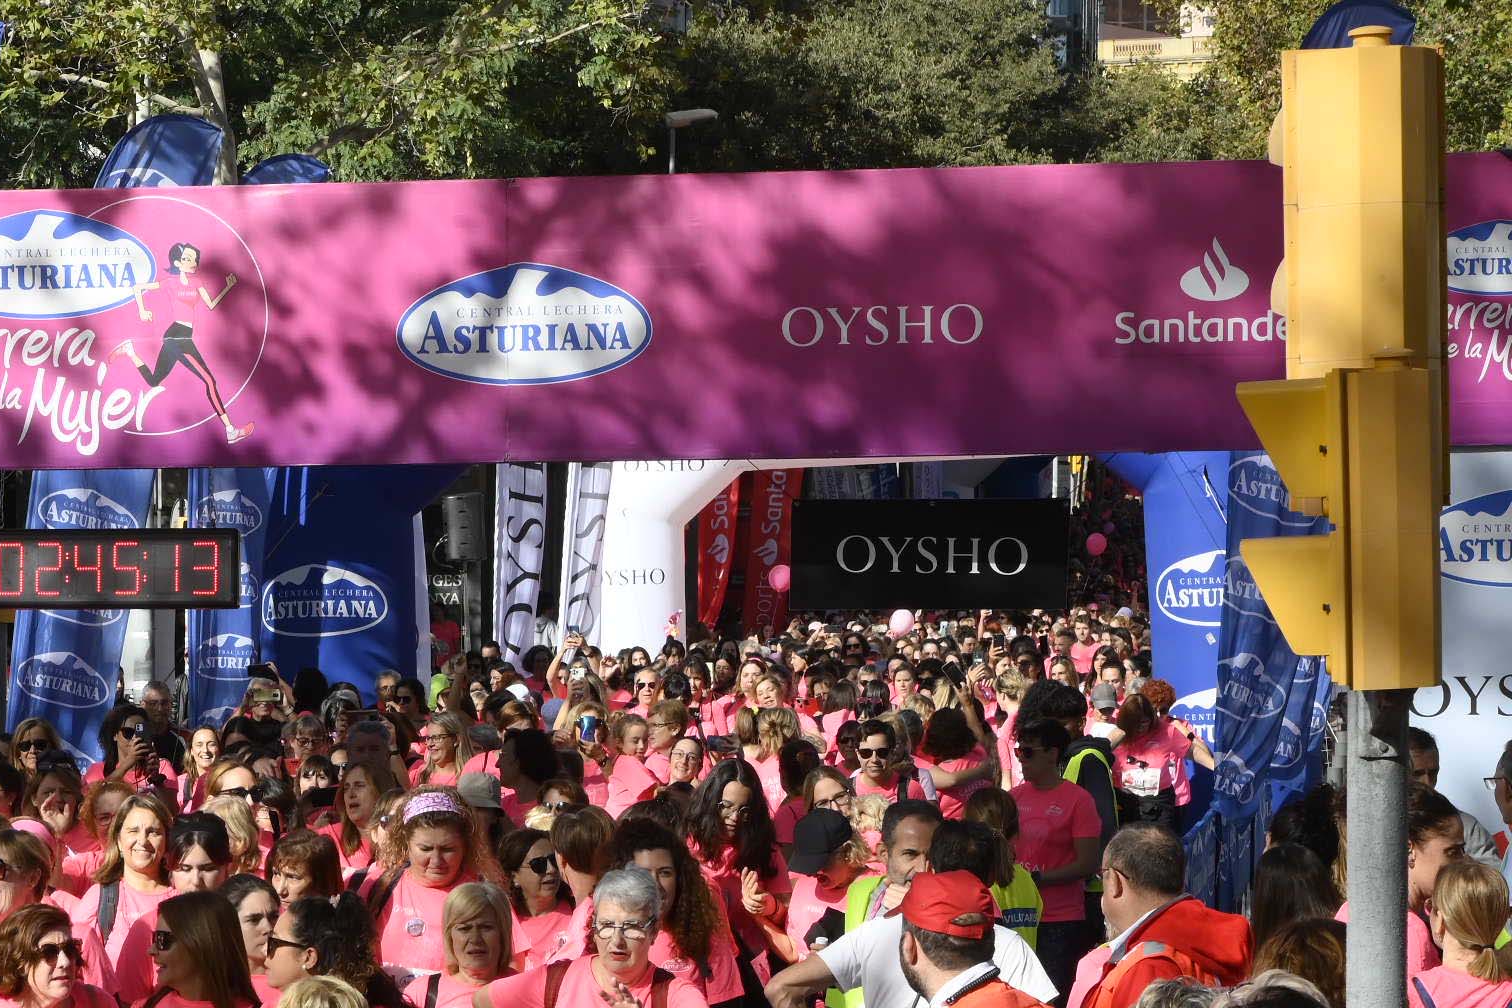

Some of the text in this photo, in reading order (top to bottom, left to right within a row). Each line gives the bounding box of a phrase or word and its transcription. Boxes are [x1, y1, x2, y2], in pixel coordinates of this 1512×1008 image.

[59, 246, 132, 258] LECHERA
[455, 303, 625, 319] CENTRAL LECHERA
[781, 303, 984, 348] OYSHO
[1114, 310, 1288, 344] Santande
[417, 310, 632, 356] ASTURIANA
[17, 362, 166, 456] Mujer
[761, 471, 787, 535] Santa
[836, 535, 1029, 576] OYSHO
[325, 588, 376, 599] LECHERA
[602, 567, 666, 586] YSHO
[266, 593, 378, 621] ASTURIANA
[25, 667, 101, 701] ASTURIANA
